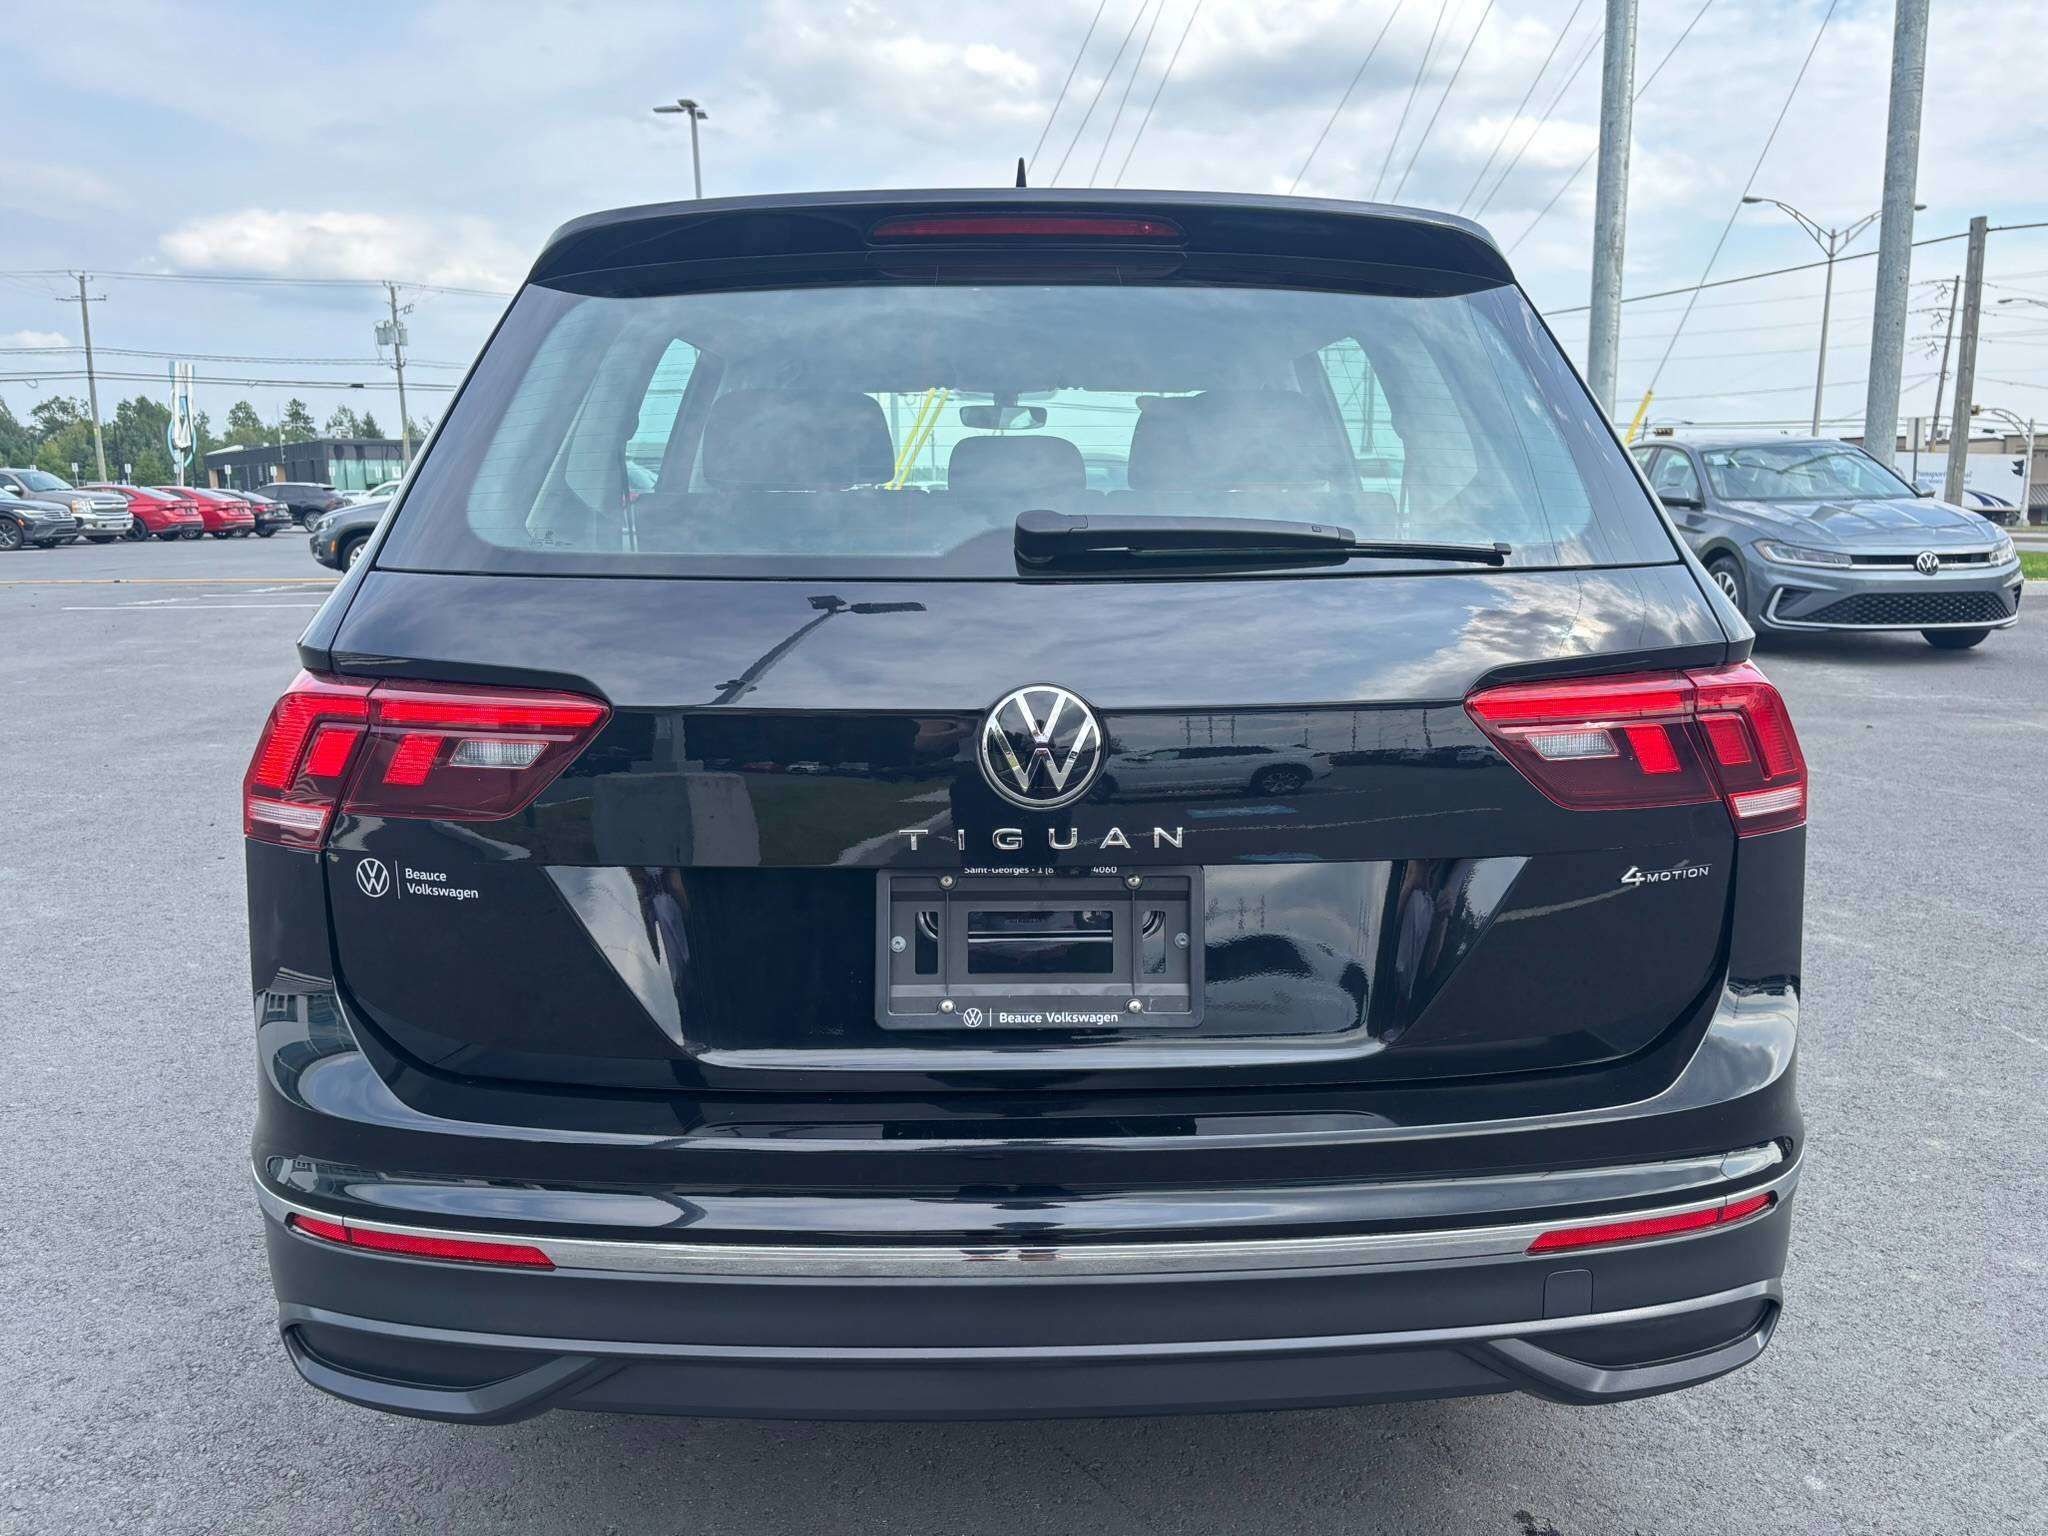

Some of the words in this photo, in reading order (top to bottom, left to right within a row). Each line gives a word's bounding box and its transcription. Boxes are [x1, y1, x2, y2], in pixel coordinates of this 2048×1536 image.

[980, 685, 1102, 808] VW
[898, 827, 1184, 850] TIGUAN
[356, 858, 389, 897] VW
[405, 868, 447, 881] Beauce
[1621, 866, 1709, 886] 4MOTION
[407, 882, 479, 900] Volkswagen
[963, 1007, 983, 1027] VW
[999, 1012, 1042, 1023] Beauce
[1046, 1011, 1119, 1025] Volkswagen
